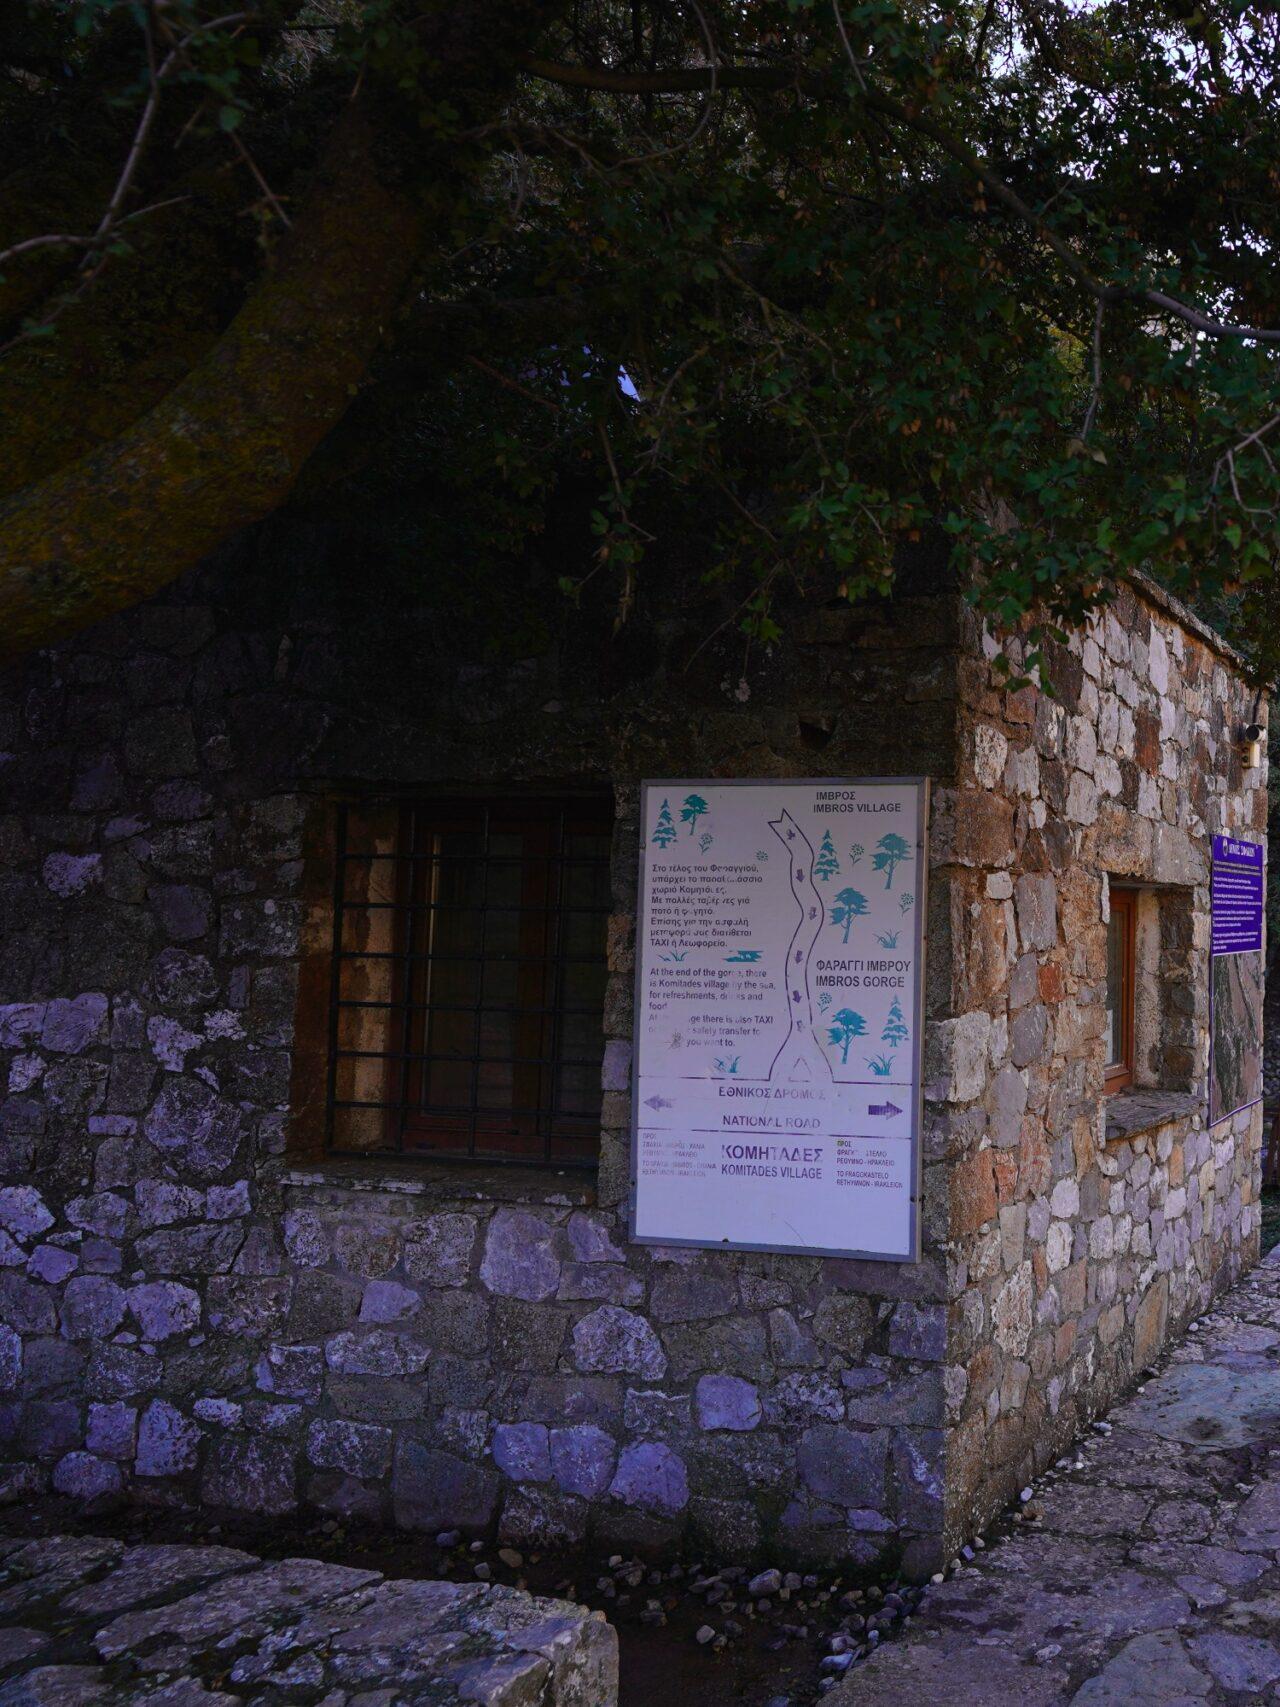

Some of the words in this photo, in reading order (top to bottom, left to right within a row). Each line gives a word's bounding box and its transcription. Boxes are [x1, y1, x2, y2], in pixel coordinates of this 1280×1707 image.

[816, 791, 856, 801] ΙΜΒΡΟΣ
[813, 803, 854, 813] IMBROS
[857, 803, 901, 813] VILLAGE
[652, 864, 667, 872] Στο
[651, 896, 662, 904] Με
[698, 919, 712, 927] την
[816, 959, 864, 972] ΦΑΡΑΓΓΙ
[867, 960, 911, 973] ΙΜΒΡΟΥ
[650, 968, 659, 976] At
[661, 968, 673, 976] the
[676, 968, 691, 977] end
[693, 968, 702, 977] of
[703, 968, 716, 977] the
[659, 979, 702, 989] Komitades
[745, 979, 757, 988] the
[816, 975, 860, 987] IMBROS
[863, 976, 905, 988] GORGE
[650, 991, 660, 999] for
[663, 991, 718, 1001] refreshments,
[748, 993, 763, 1001] and
[703, 1015, 724, 1024] there
[755, 1016, 774, 1025] TAXI
[719, 1027, 750, 1036] transfer
[725, 1039, 736, 1047] to.
[719, 1086, 771, 1099] ΕΘΝΙΚΟΣ
[723, 1115, 782, 1128] NATIONAL
[785, 1117, 821, 1129] ROAD
[722, 1145, 823, 1163] ΚΟΜΗΤΑΔΕΣ
[721, 1164, 777, 1177] KOMITADES
[780, 1166, 822, 1180] VILLAGE
